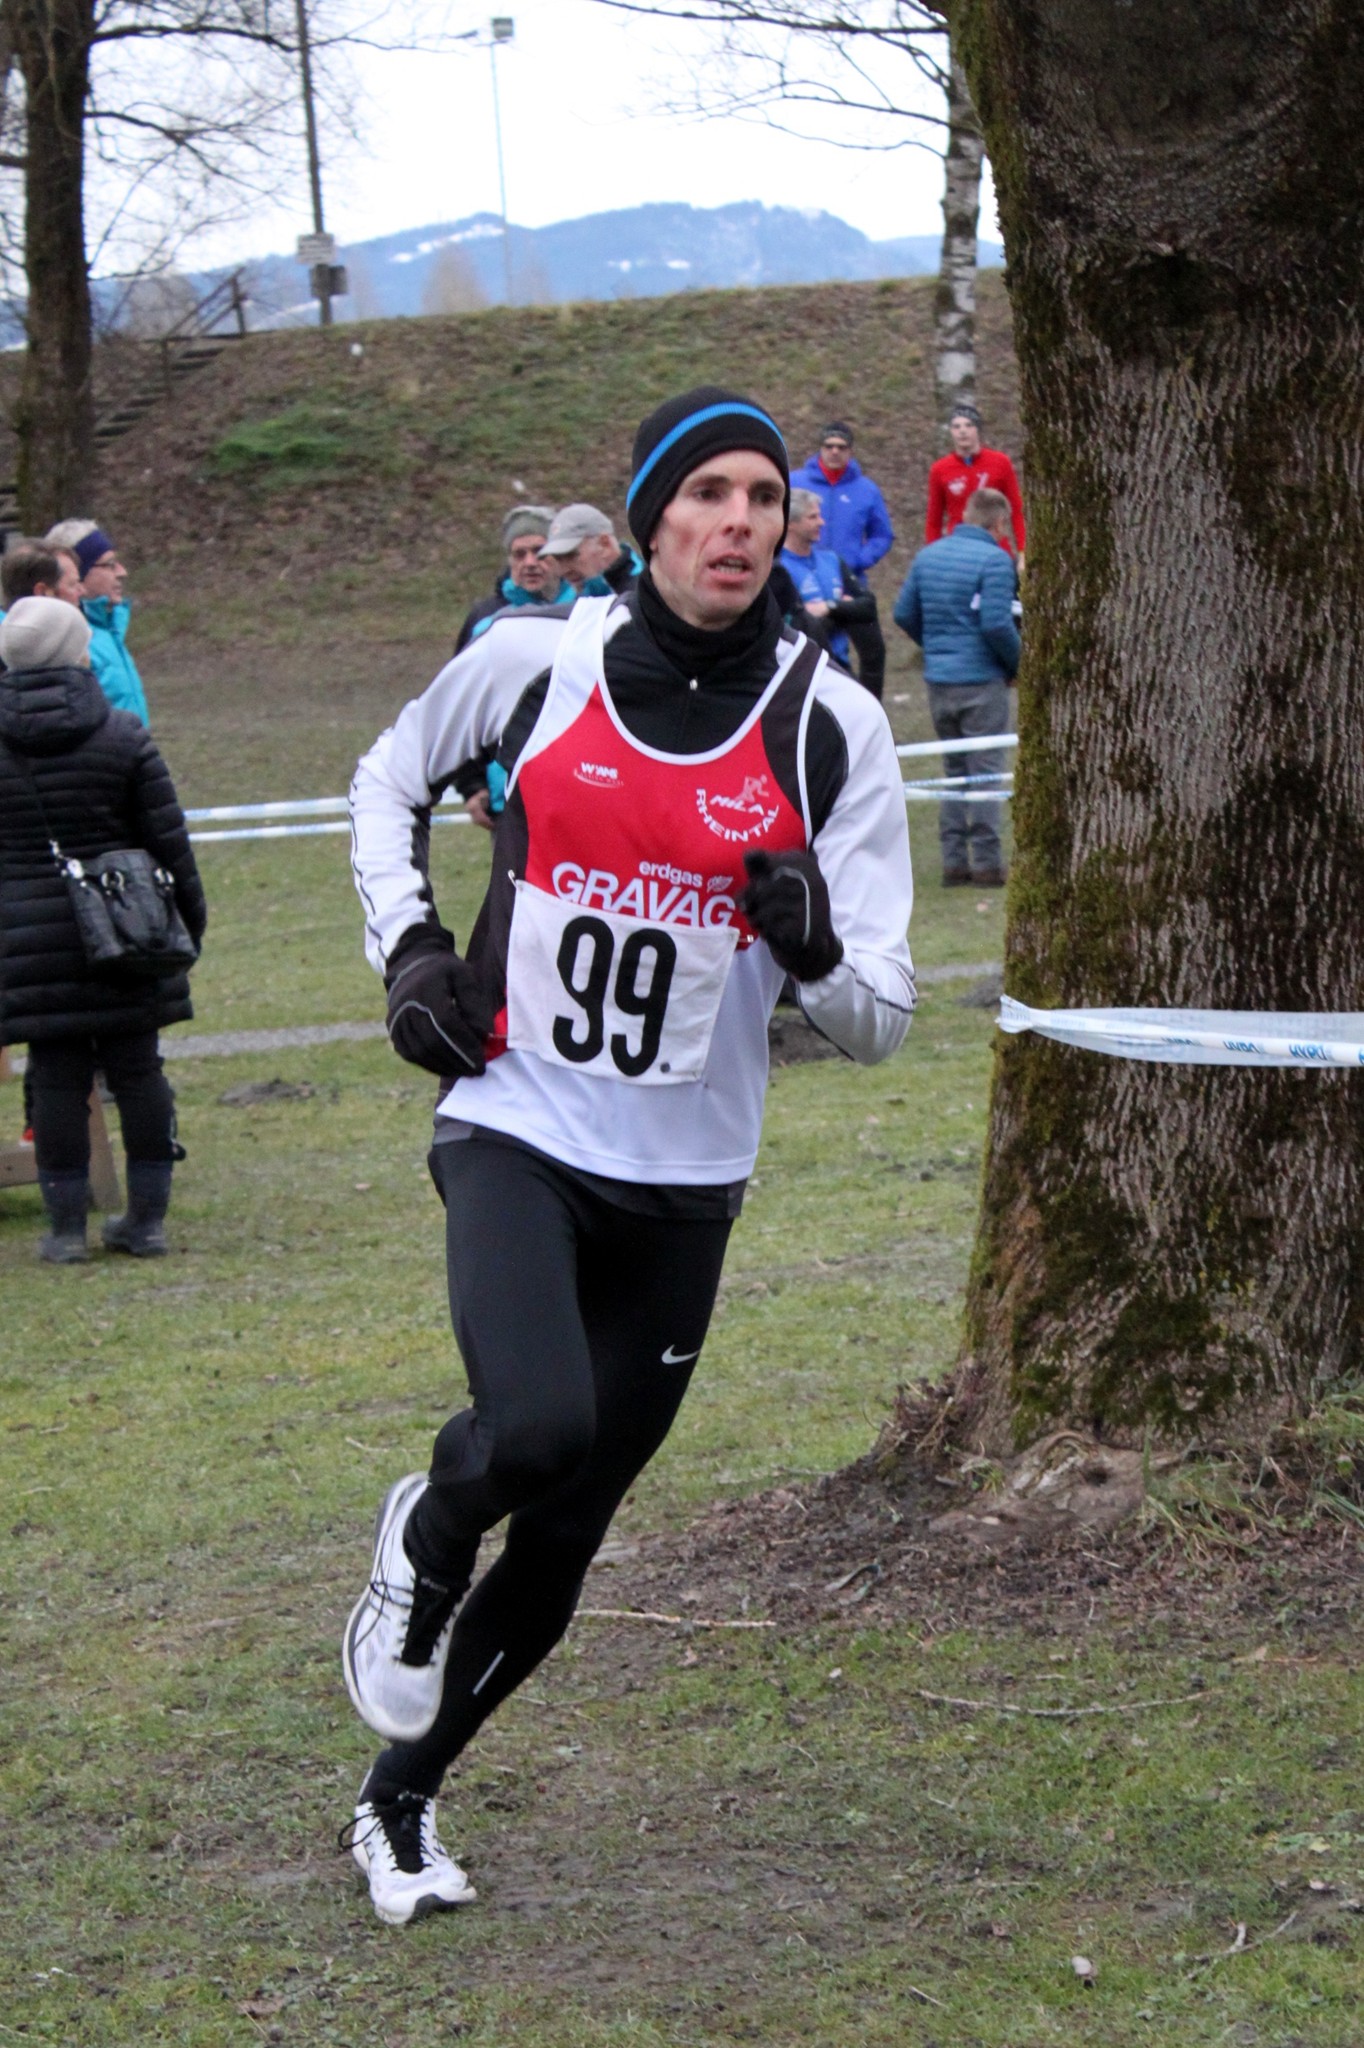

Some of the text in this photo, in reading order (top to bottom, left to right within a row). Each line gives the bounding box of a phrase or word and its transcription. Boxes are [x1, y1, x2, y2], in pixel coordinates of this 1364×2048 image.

[696, 788, 779, 842] RHEINTAL
[710, 795, 764, 816] MILA
[638, 861, 703, 888] erdgas
[551, 861, 736, 929] GRAVAG
